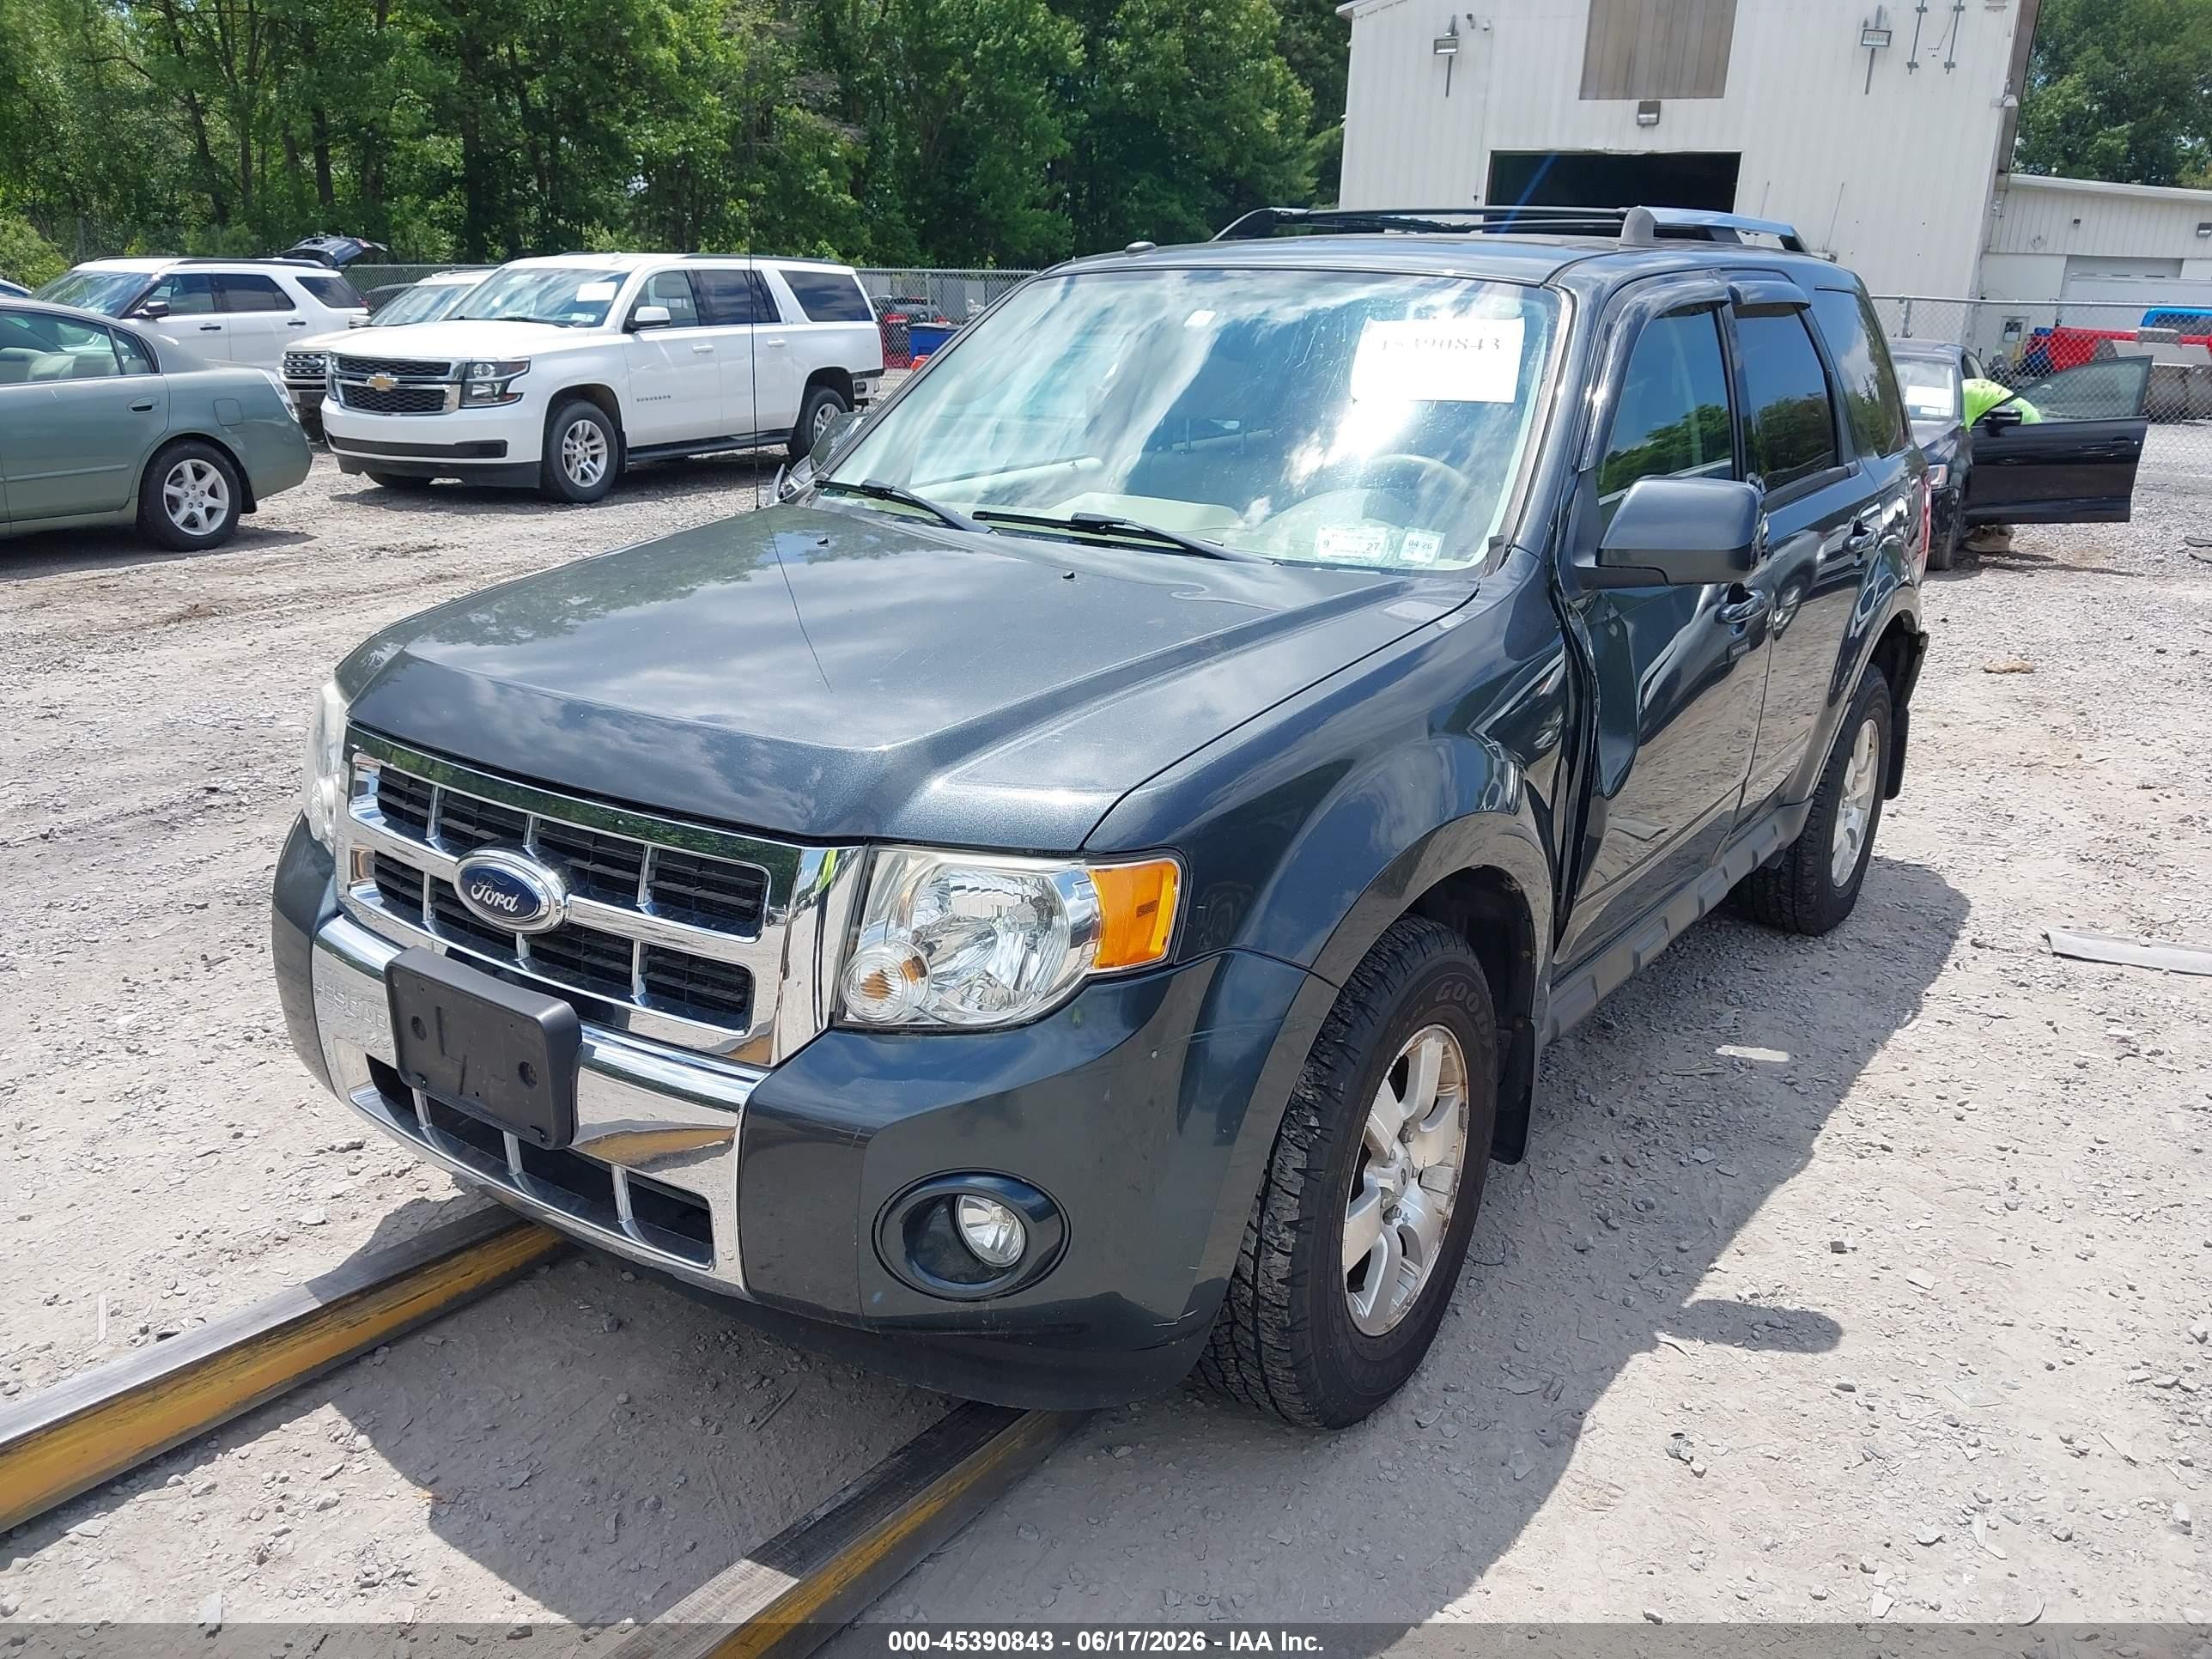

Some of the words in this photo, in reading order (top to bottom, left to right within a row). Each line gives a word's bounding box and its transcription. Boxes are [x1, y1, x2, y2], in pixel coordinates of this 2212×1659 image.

[1366, 542, 1381, 551] 27
[470, 873, 520, 913] Ford
[322, 981, 386, 1030] ESCAP
